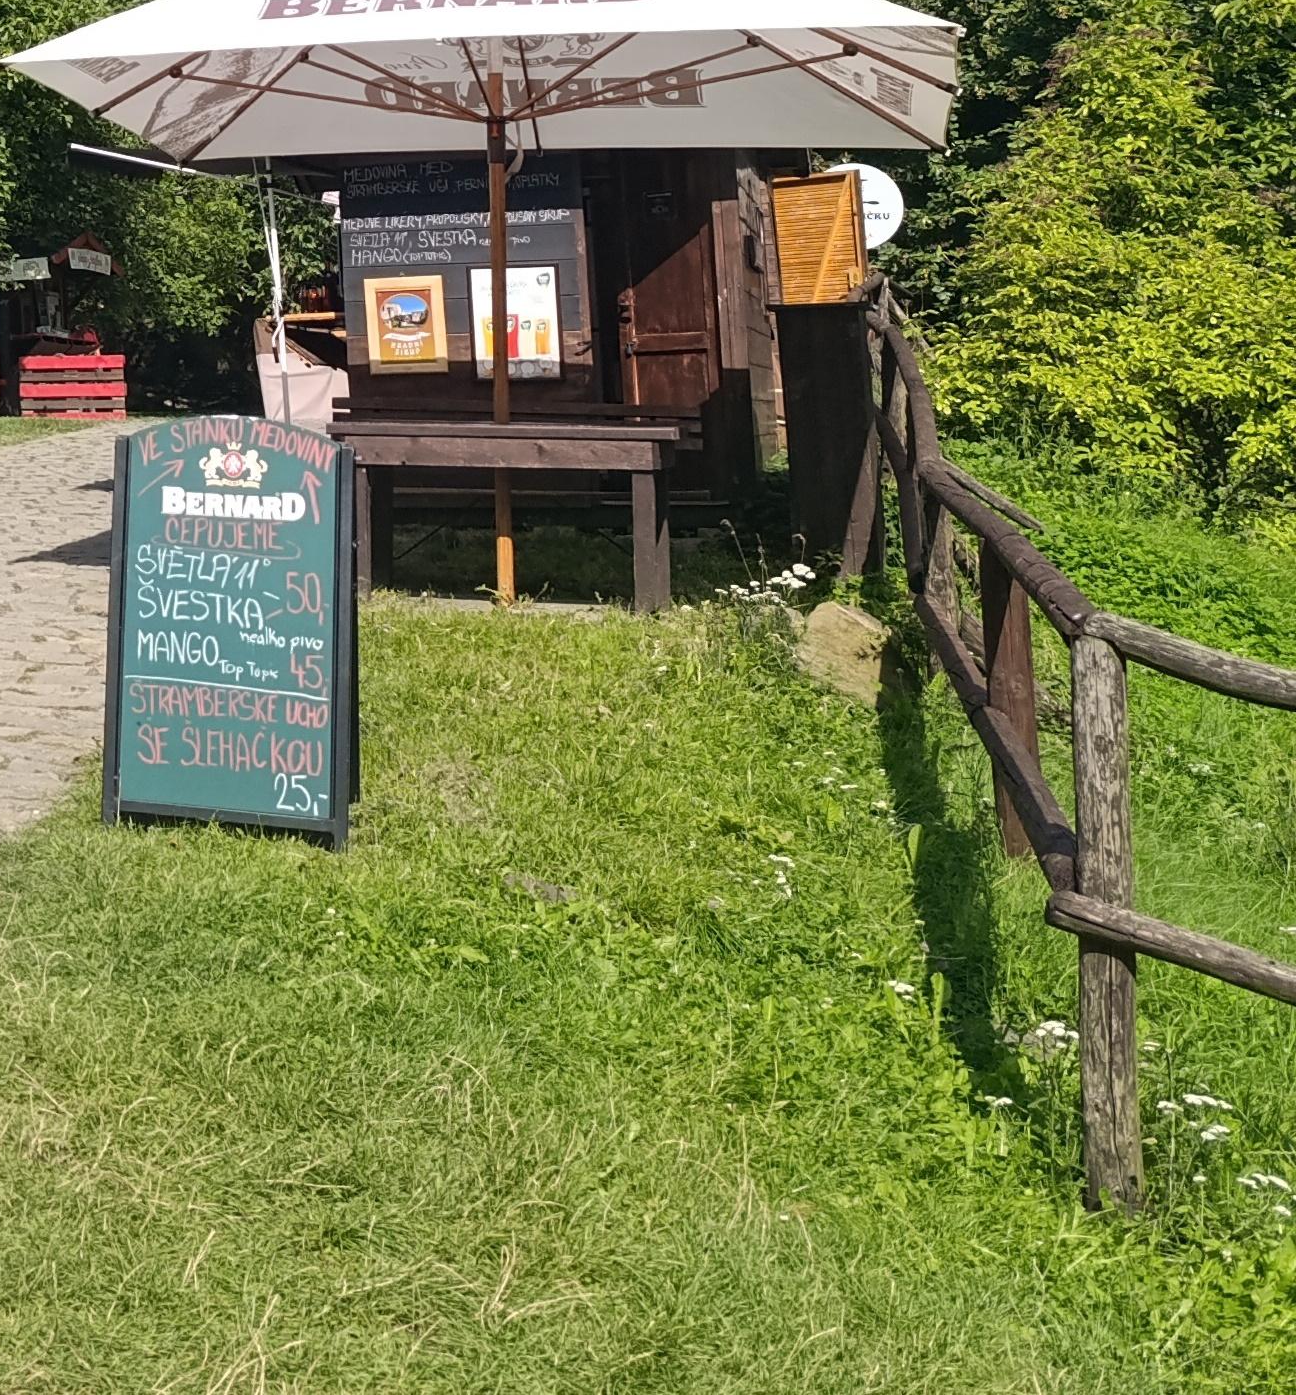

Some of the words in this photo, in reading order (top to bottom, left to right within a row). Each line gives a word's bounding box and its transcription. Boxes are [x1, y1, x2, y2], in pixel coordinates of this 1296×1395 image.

[138, 430, 164, 466] VE
[249, 419, 337, 474] MEDOVINY
[161, 485, 306, 522] BERNARD
[136, 575, 265, 631] ŠVESTKA
[137, 628, 220, 666] MANGO
[218, 659, 244, 682] Top
[240, 626, 286, 648] nealko
[290, 637, 324, 654] pivo
[286, 699, 329, 729] UCHO
